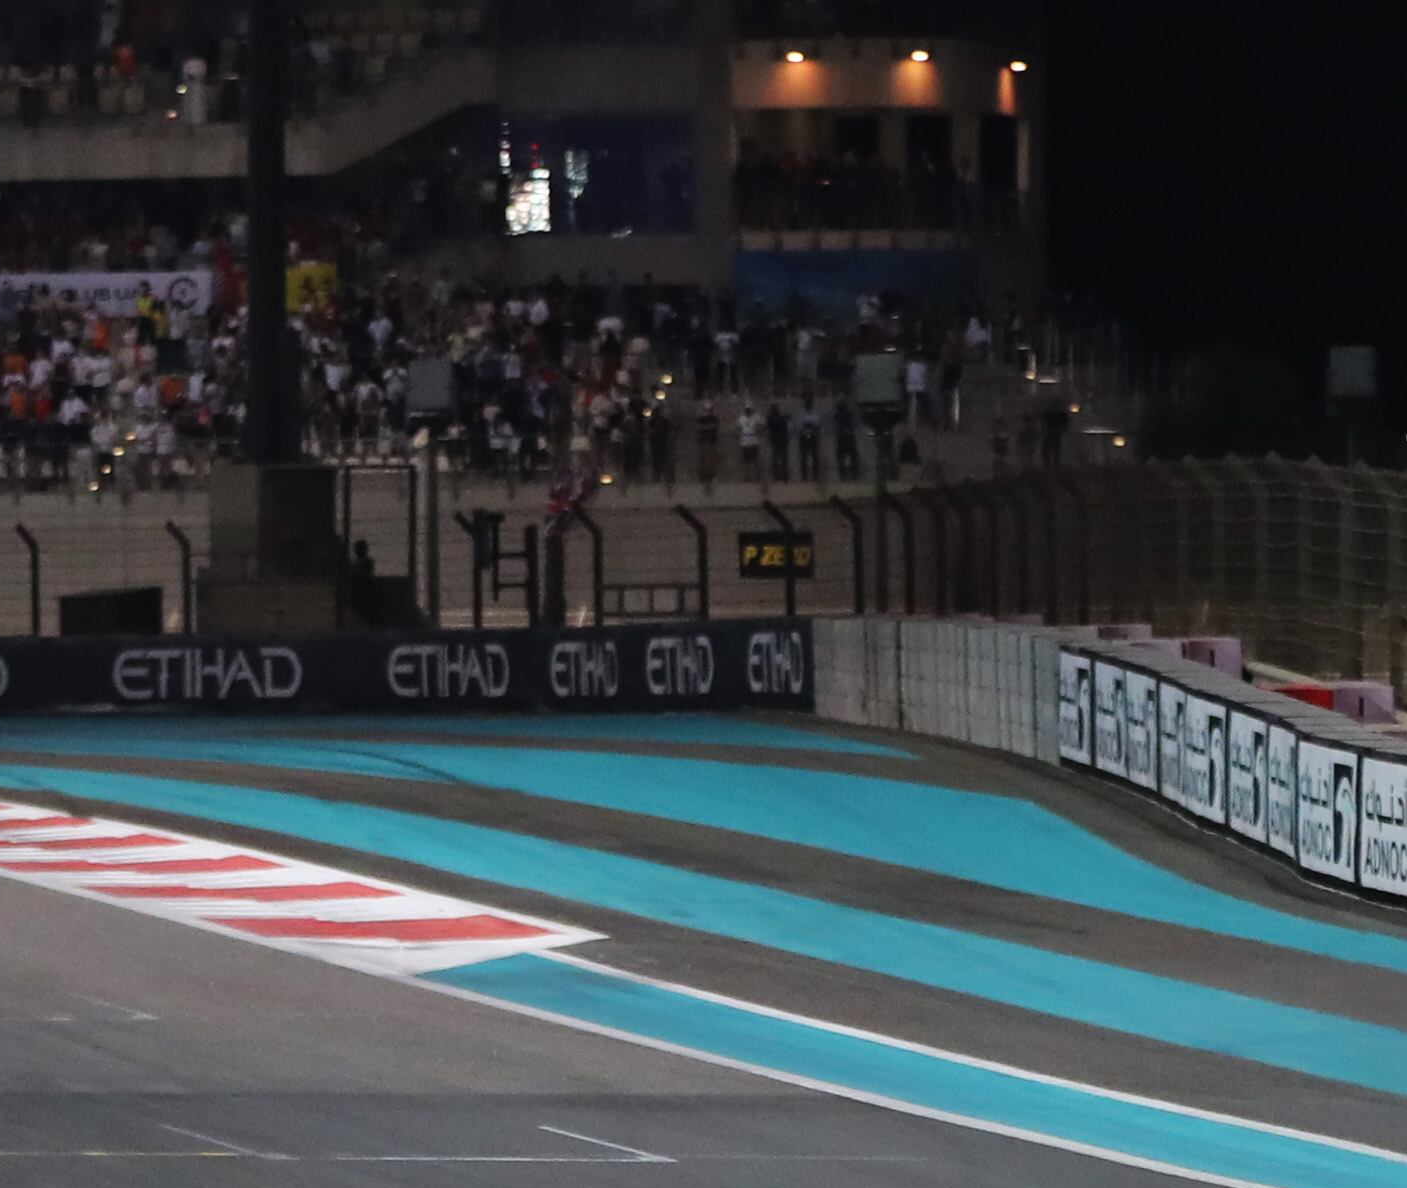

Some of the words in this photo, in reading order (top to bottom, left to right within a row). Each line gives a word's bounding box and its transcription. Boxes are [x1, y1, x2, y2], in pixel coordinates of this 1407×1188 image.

[760, 544, 811, 567] ZEO
[113, 648, 303, 700] ETIHAD
[388, 644, 510, 699] ETIHAD
[1364, 838, 1407, 882] ADNOC
